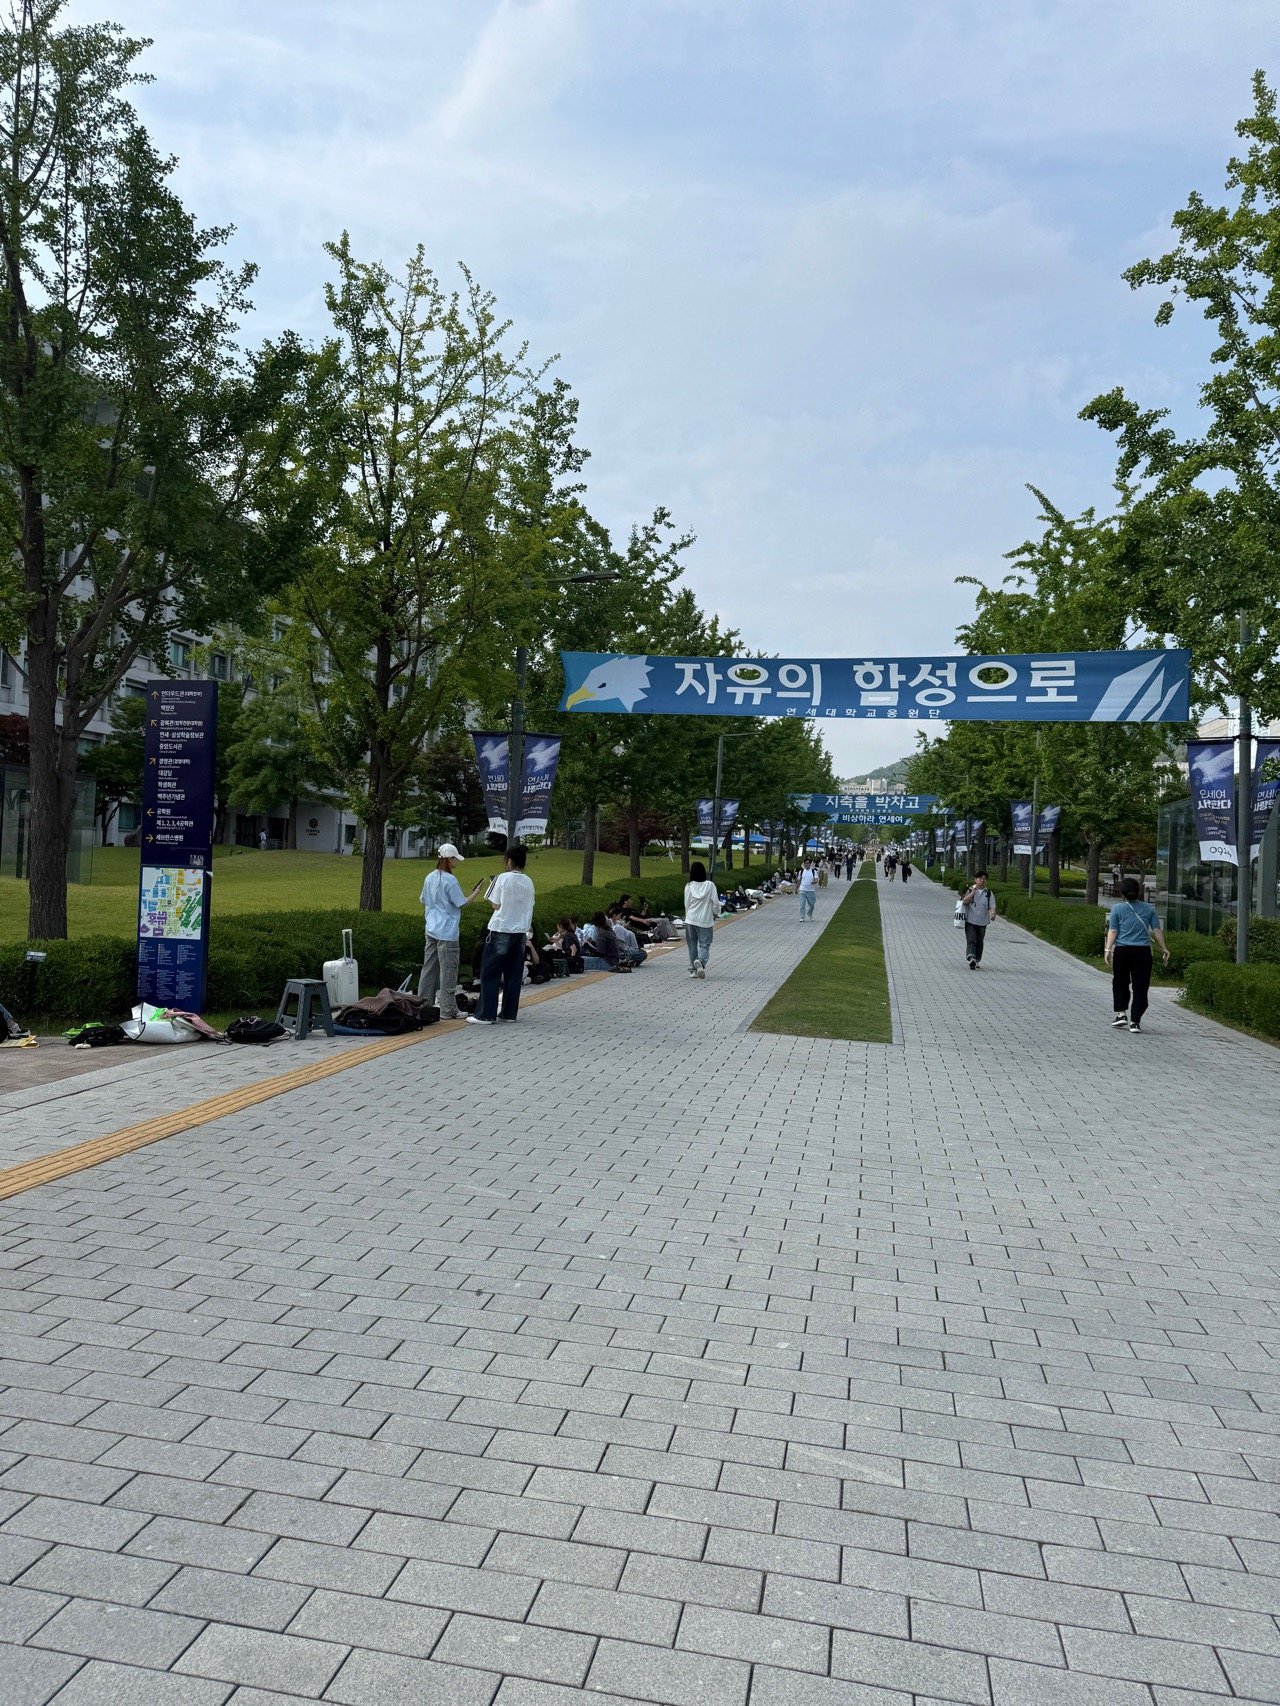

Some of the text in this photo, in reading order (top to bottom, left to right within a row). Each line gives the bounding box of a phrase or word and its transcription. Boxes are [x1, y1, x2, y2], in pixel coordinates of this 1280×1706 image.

[675, 660, 1078, 707] 자유의 함성으로
[786, 707, 941, 719] 연세대학교응원단
[825, 795, 920, 809] 지축을 박차고
[155, 834, 184, 842] 세브란스병원
